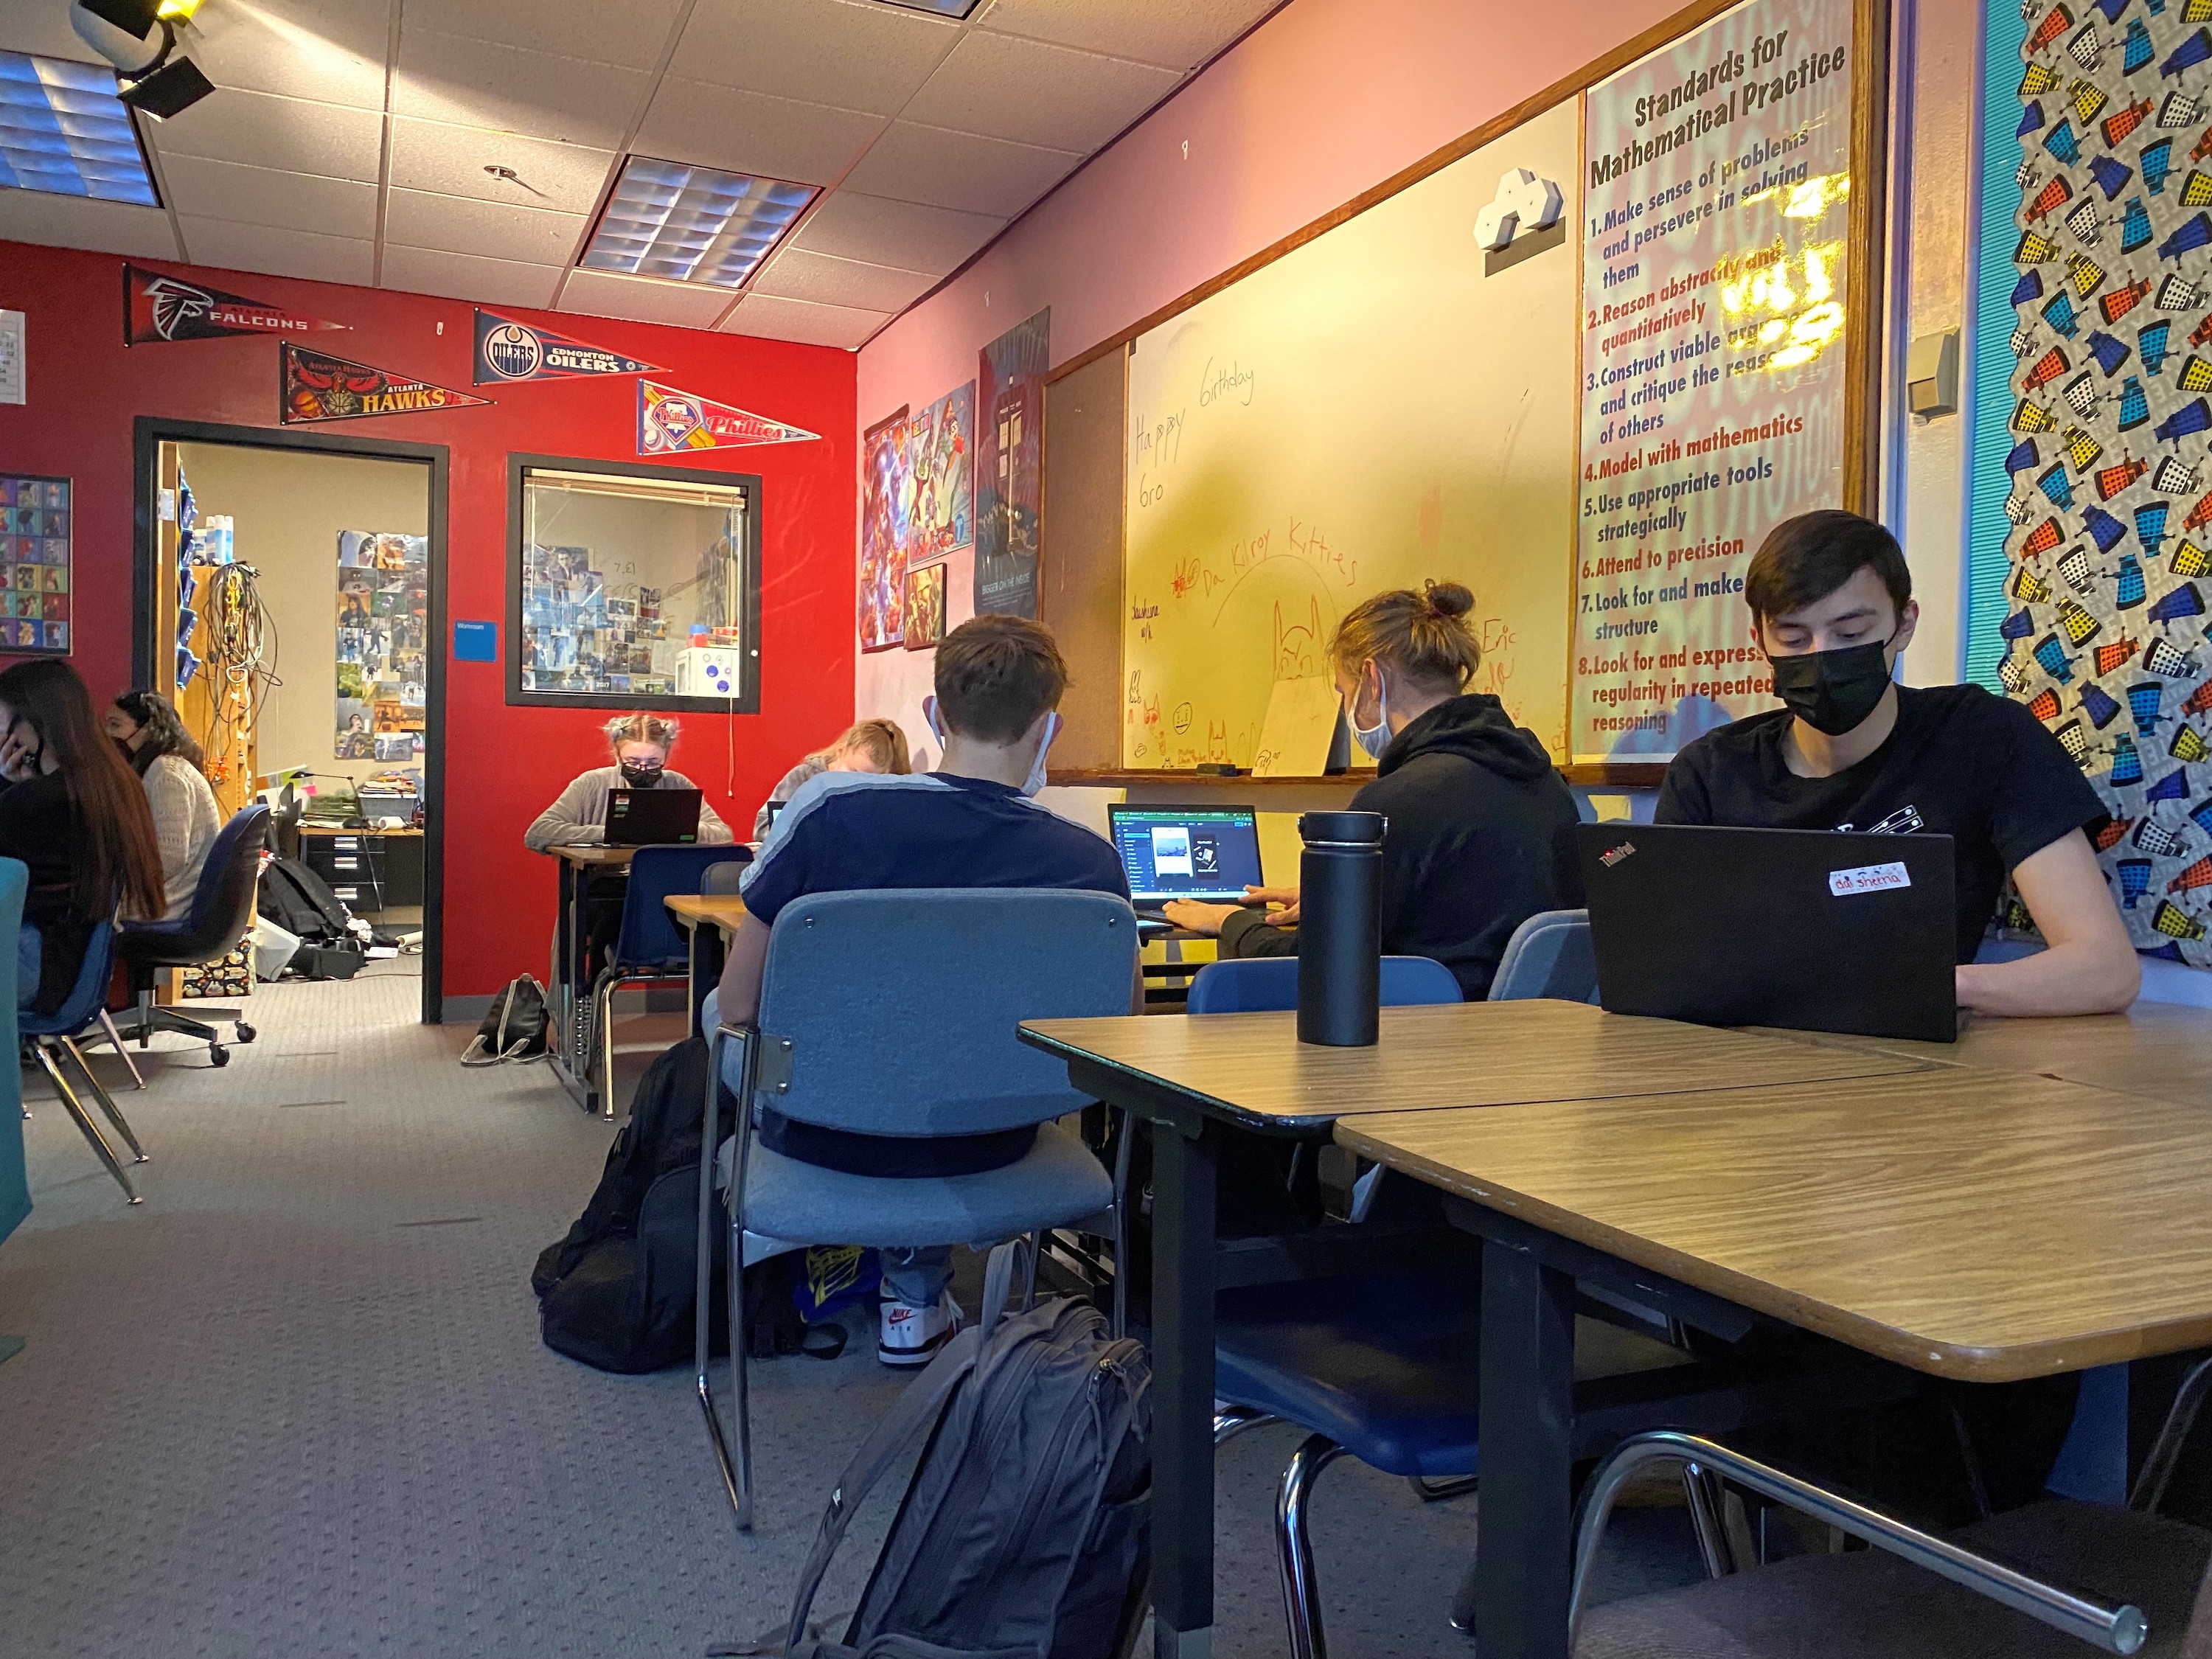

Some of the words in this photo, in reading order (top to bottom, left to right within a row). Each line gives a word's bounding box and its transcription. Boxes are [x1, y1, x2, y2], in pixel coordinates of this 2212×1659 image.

[1635, 51, 1745, 127] Standards
[1751, 30, 1788, 69] for
[1591, 91, 1736, 189] Mathematical
[1742, 46, 1845, 116] Practice
[1604, 201, 1643, 232] Make
[1649, 180, 1692, 211] sense
[1699, 160, 1716, 187] of
[1722, 129, 1809, 185] problems
[1603, 230, 1630, 260] and
[1635, 202, 1713, 253] persevere
[1718, 189, 1734, 211] in
[1742, 161, 1808, 198] solving
[1603, 263, 1639, 289] them
[209, 311, 307, 330] FALCONS
[1603, 292, 1655, 324] Reason
[1601, 299, 1706, 357] quantitatively
[493, 342, 535, 361] OILERS
[546, 355, 620, 373] OILERS
[552, 347, 614, 361] EDMONTON
[1601, 349, 1665, 386] Construct
[1671, 330, 1720, 364] viable
[363, 390, 446, 413] HAWKS
[388, 383, 424, 393] ATLANTA
[1600, 389, 1626, 416] and
[1631, 377, 1686, 406] critique
[1693, 364, 1719, 387] the
[657, 406, 695, 425] Phillies
[706, 415, 783, 440] Phillies
[1600, 422, 1614, 444] of
[1618, 414, 1663, 439] others
[1599, 448, 1642, 479] Model
[1648, 439, 1680, 466] with
[1687, 413, 1803, 457] mathematics
[1599, 495, 1622, 514] Use
[1628, 471, 1720, 511] appropriate
[1728, 456, 1773, 485] tools
[1598, 506, 1686, 543] strategically
[1596, 549, 1641, 577] Attend
[1648, 548, 1662, 568] to
[1668, 535, 1744, 571] precision
[981, 581, 998, 595] BIGGER
[1203, 569, 1225, 597] Da
[1596, 588, 1628, 612] Look
[1633, 585, 1654, 606] for
[1659, 577, 1688, 602] and
[1694, 572, 1743, 598] make
[1483, 619, 1517, 653] Eric
[1596, 619, 1658, 640] structure
[1593, 652, 1628, 674] Look
[1633, 650, 1654, 671] for
[1659, 645, 1686, 668] and
[1593, 679, 1666, 708] regularity
[1672, 678, 1686, 698] in
[1691, 675, 1774, 703] repeated
[1593, 709, 1666, 734] reasoning
[1599, 841, 1635, 867] ThinkPad
[893, 1308, 912, 1318] NIKE
